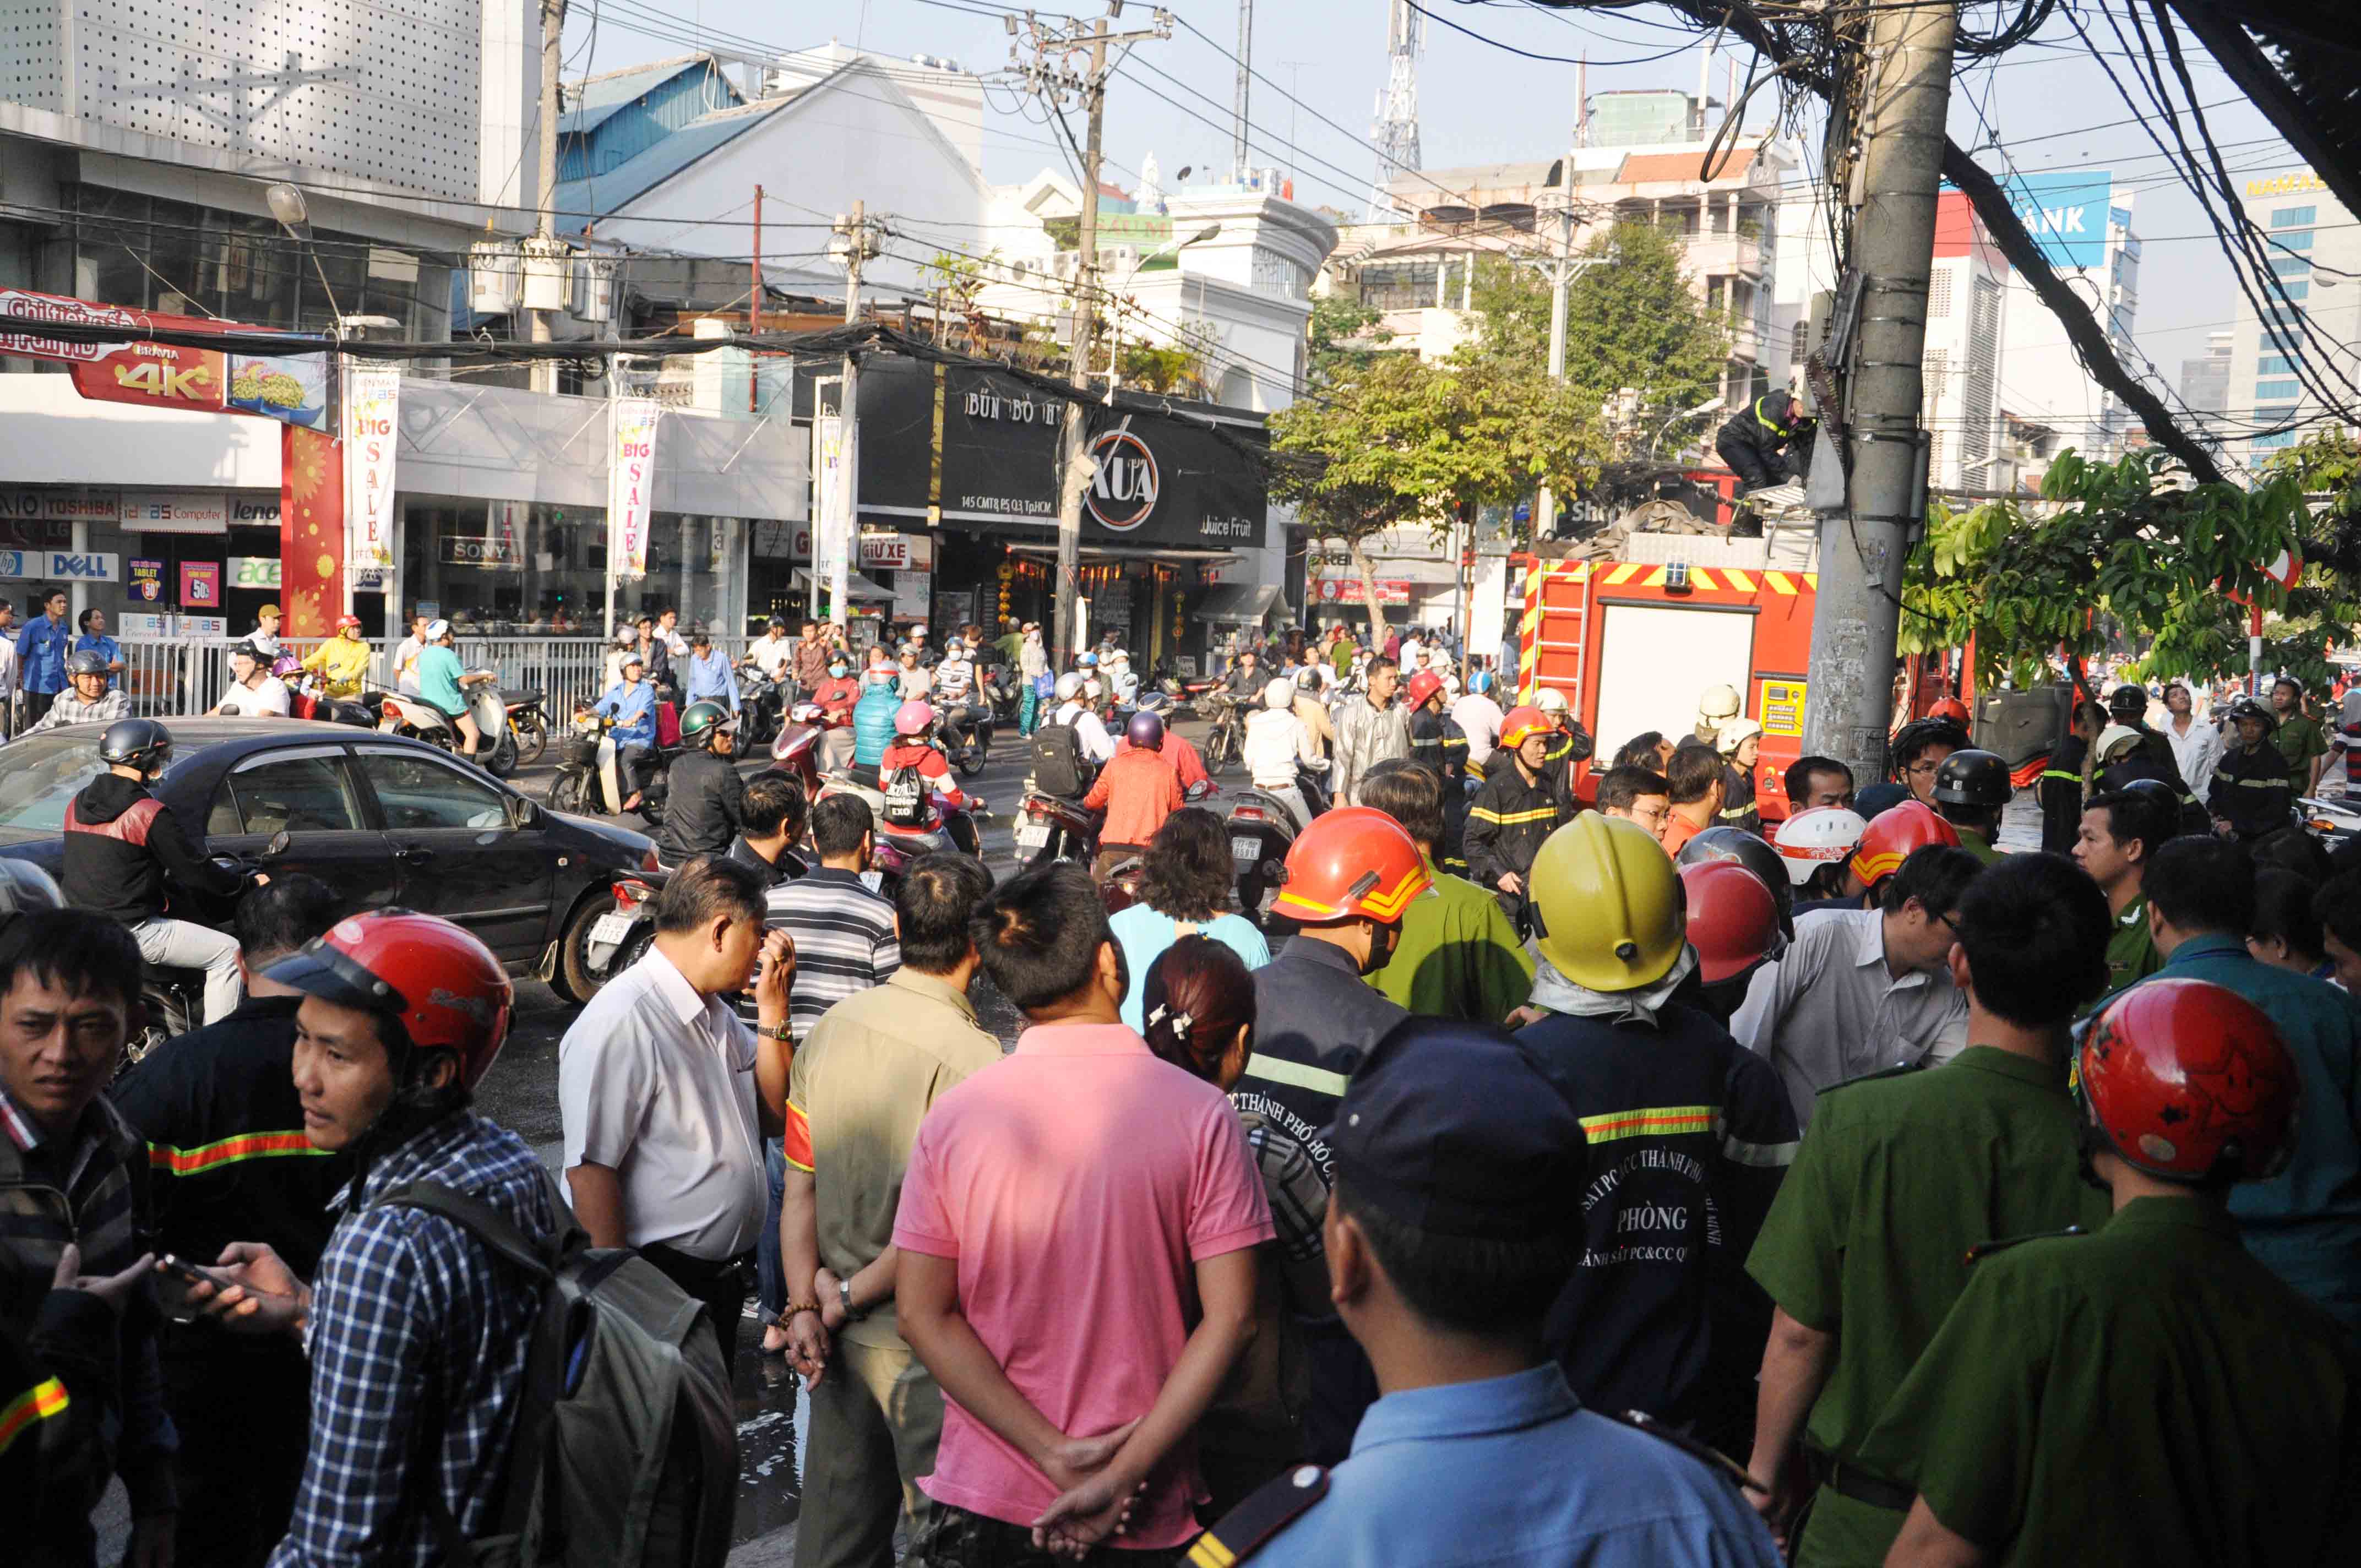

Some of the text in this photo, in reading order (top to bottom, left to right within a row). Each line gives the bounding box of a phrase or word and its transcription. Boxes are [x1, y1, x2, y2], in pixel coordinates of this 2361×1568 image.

[137, 345, 179, 360] BRAVIA
[118, 363, 203, 400] 4K
[624, 443, 650, 458] BIG
[47, 498, 115, 515] TOSHIBA
[233, 499, 281, 520] leno
[625, 464, 641, 552] SALE
[962, 496, 975, 508] 145
[174, 507, 221, 521] Computer
[1201, 515, 1251, 538] Juice Fruit
[454, 542, 507, 559] SONY
[887, 543, 906, 558] XE
[53, 554, 107, 578] DELL
[237, 561, 281, 584] ace
[892, 807, 911, 816] EXO
[1239, 1091, 1285, 1121] THÀNH
[1283, 1111, 1317, 1141] PHỐ
[1307, 1140, 1335, 1162] HỒ
[1640, 1146, 1686, 1172] THÀNH
[1617, 1200, 1688, 1233] PHÒNG
[1629, 1246, 1674, 1261] PC&CC
